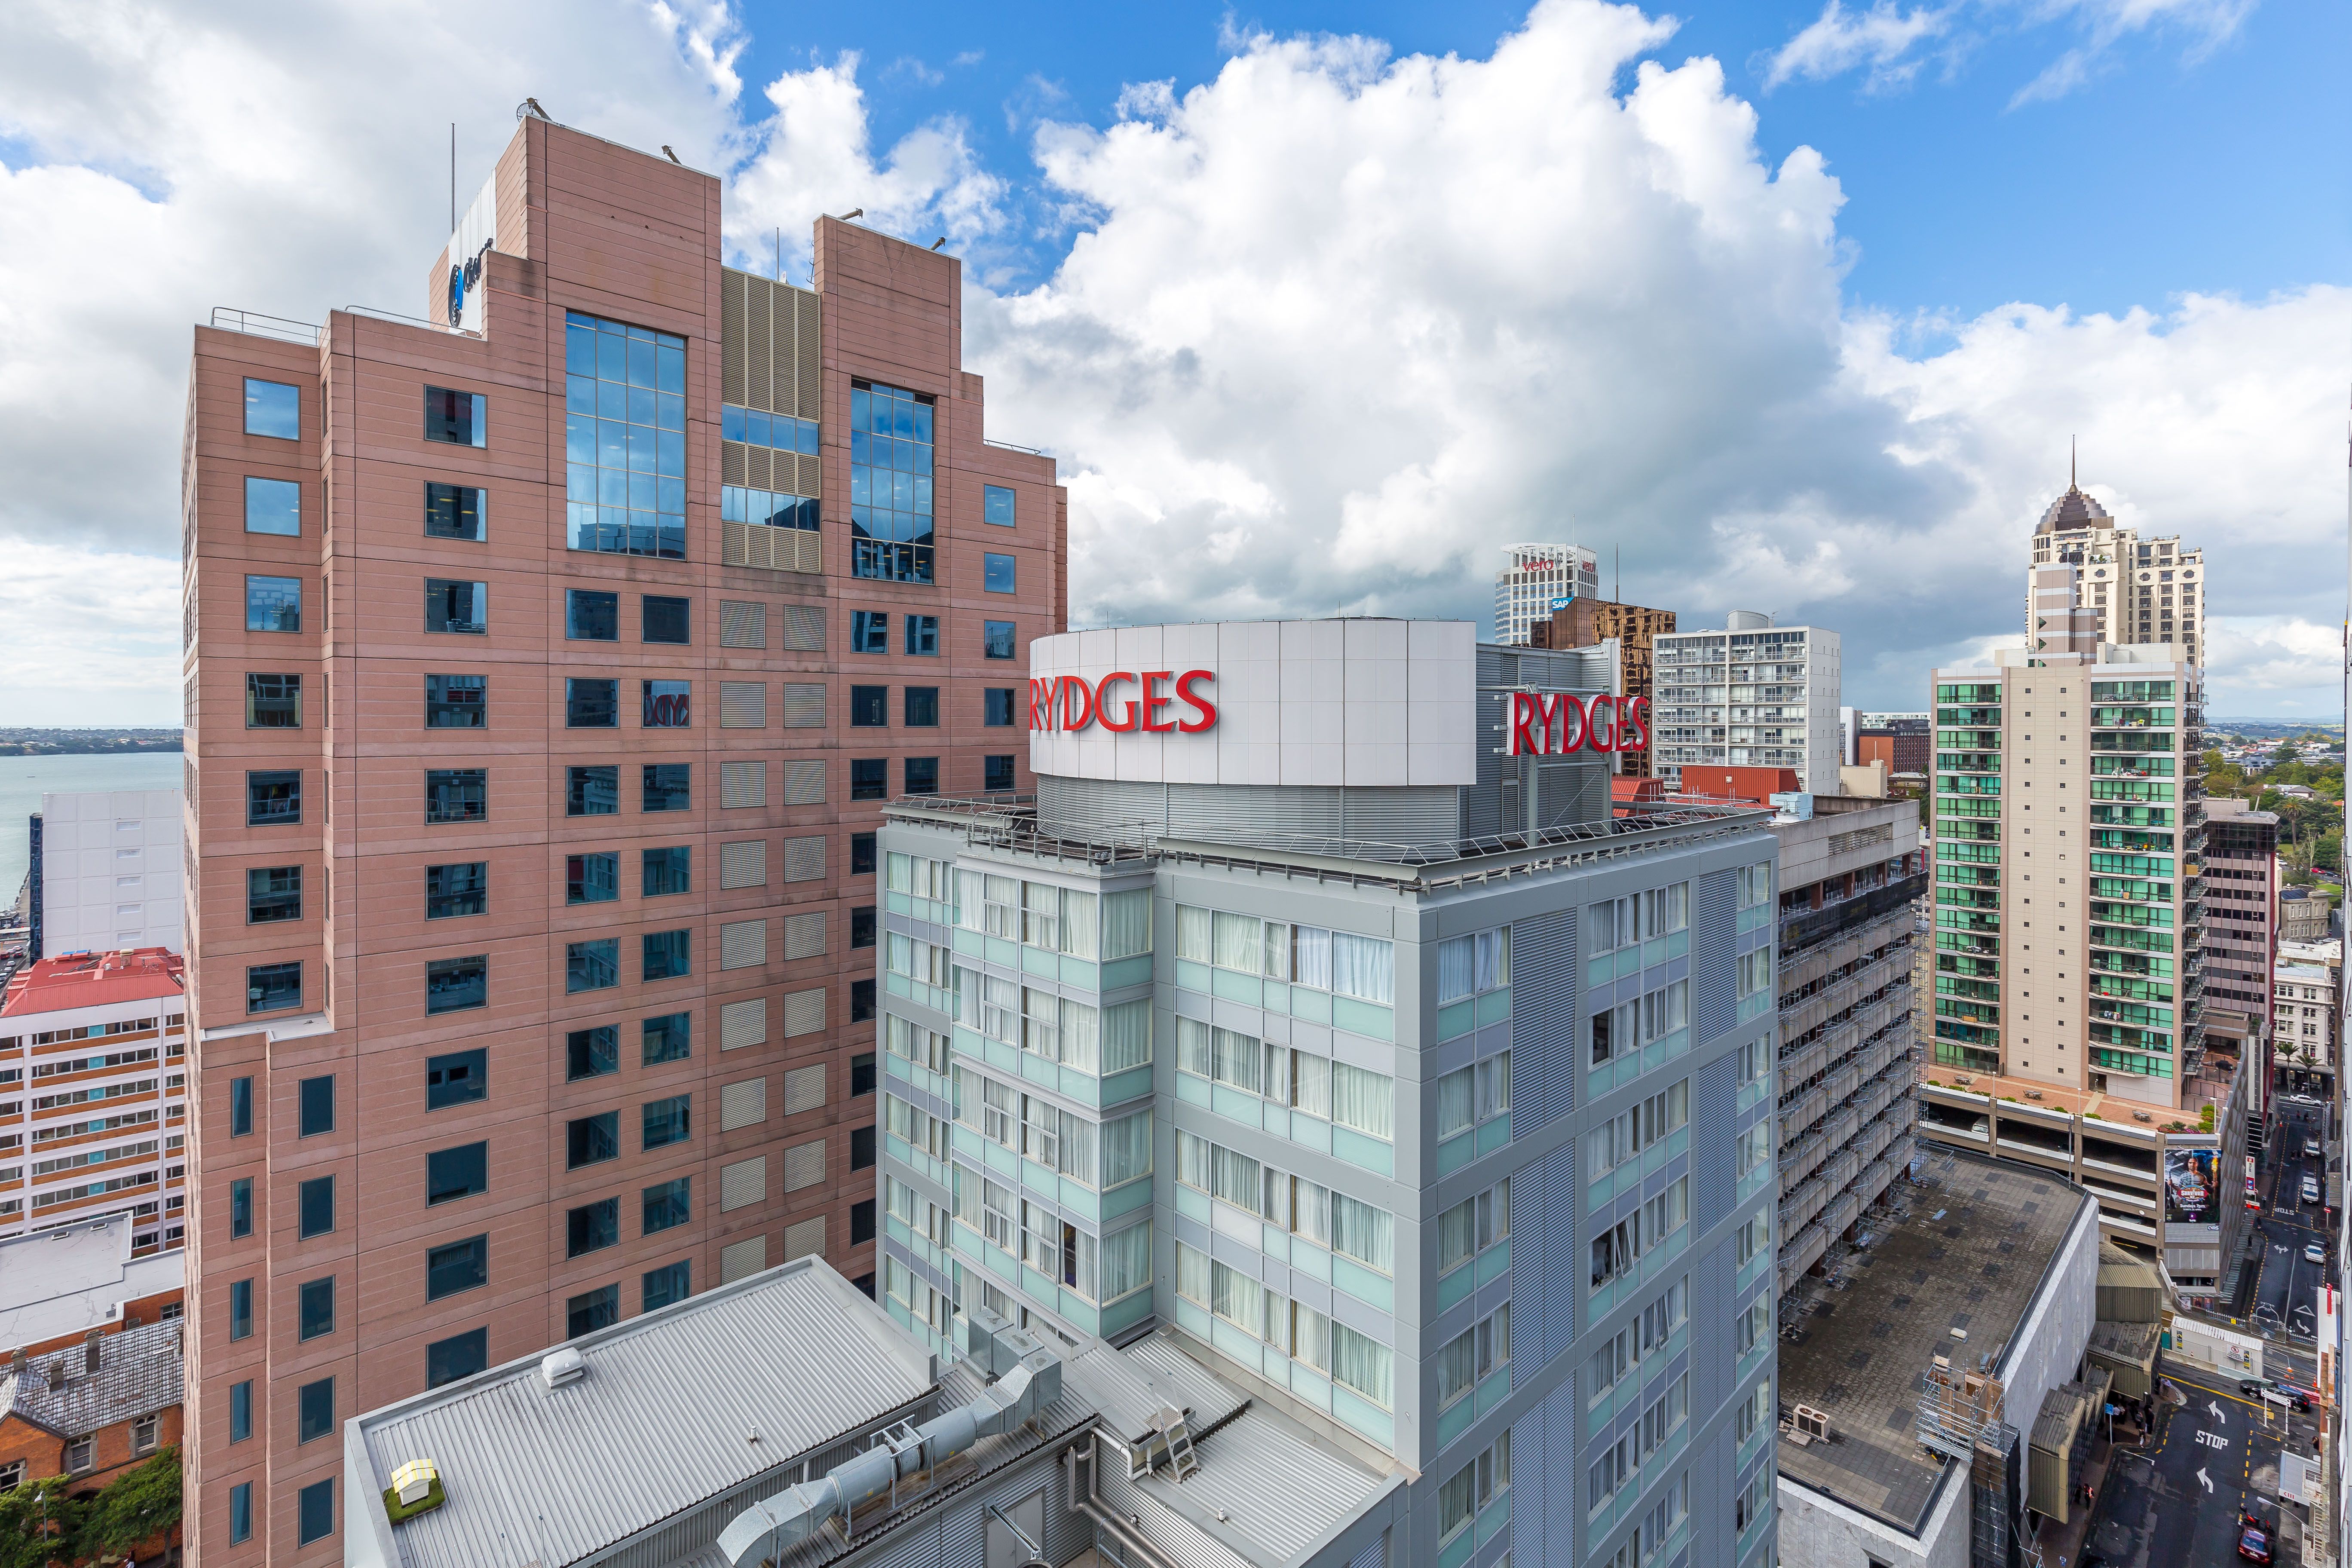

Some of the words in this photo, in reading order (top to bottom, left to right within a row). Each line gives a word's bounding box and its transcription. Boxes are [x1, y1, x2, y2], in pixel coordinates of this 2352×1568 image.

[1523, 560, 1554, 571] vero
[1582, 560, 1594, 573] vero
[1552, 600, 1569, 609] SAP
[1029, 670, 1218, 732] RYDGES
[1507, 692, 1648, 756] RYDGES
[2275, 1207, 2294, 1216] STOP
[2195, 1430, 2229, 1450] STOP
